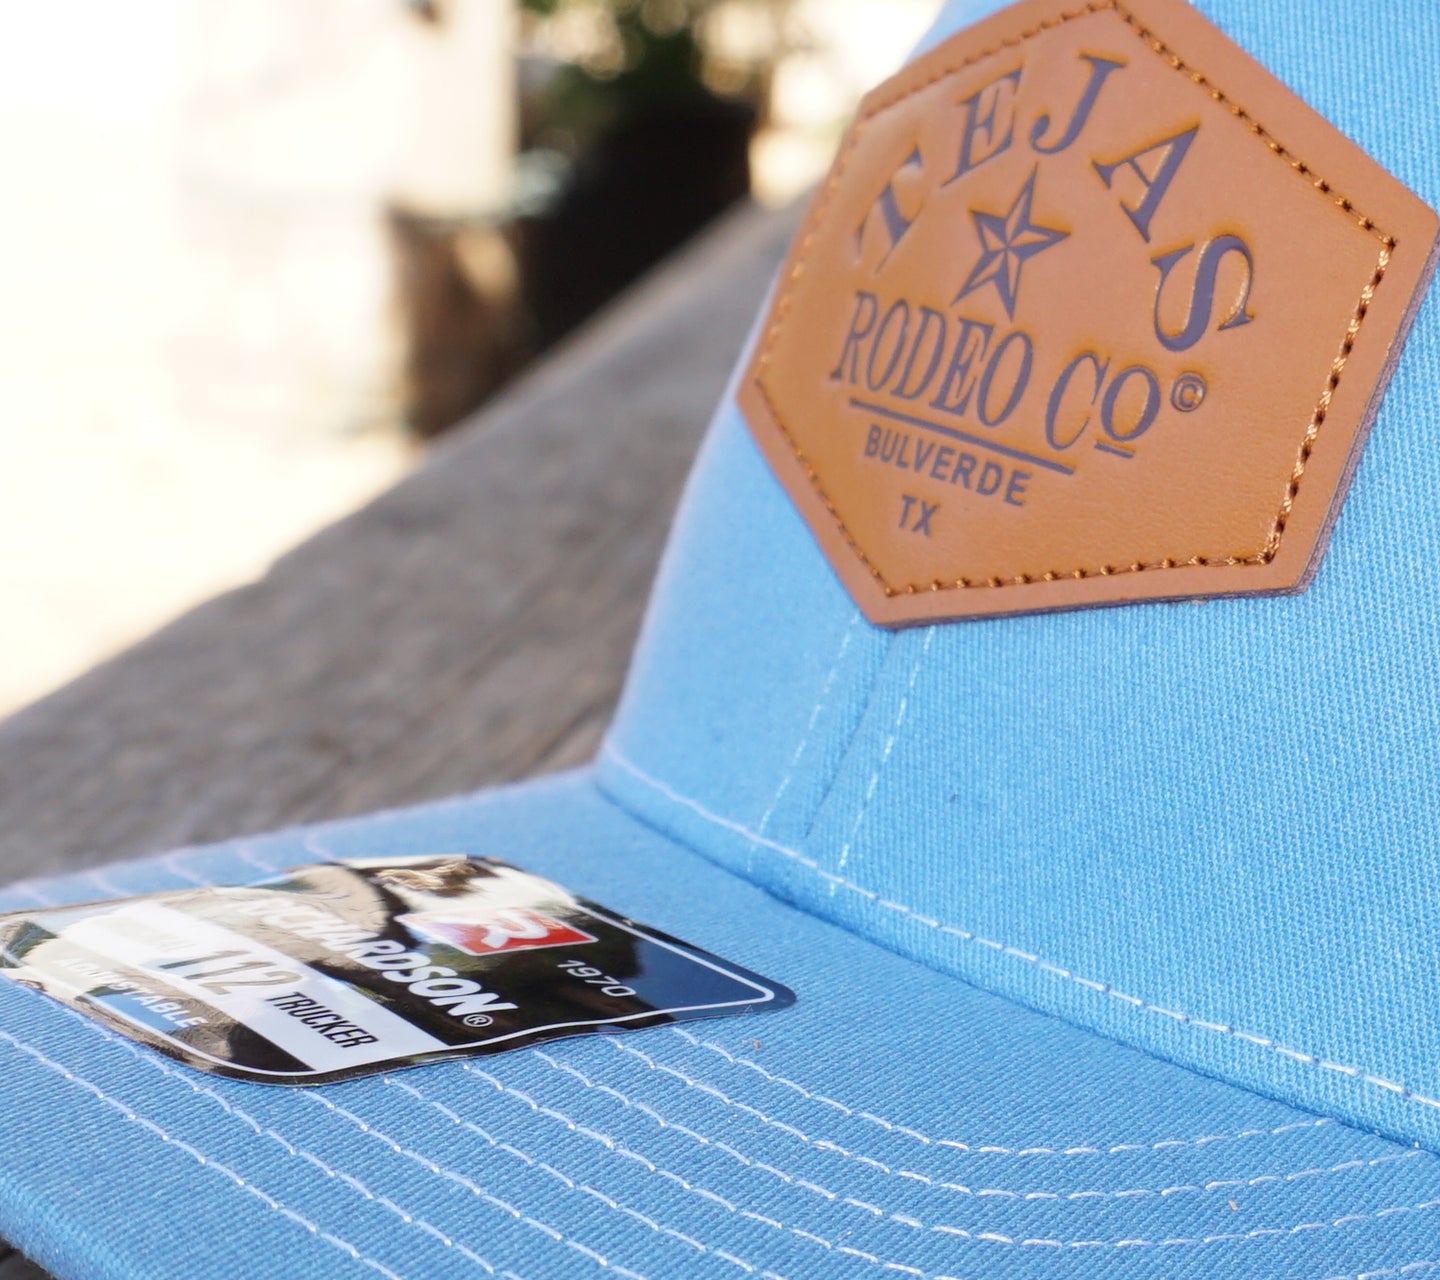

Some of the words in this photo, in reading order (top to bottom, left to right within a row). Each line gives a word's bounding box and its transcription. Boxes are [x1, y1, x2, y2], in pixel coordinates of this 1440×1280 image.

[854, 53, 1256, 353] TEJAS
[828, 289, 1035, 428] RODEO
[863, 424, 1034, 507] BULVERDE
[897, 493, 941, 537] TX
[159, 949, 304, 995] 112
[264, 991, 381, 1049] TRUCKER
[556, 959, 638, 998] 1970
